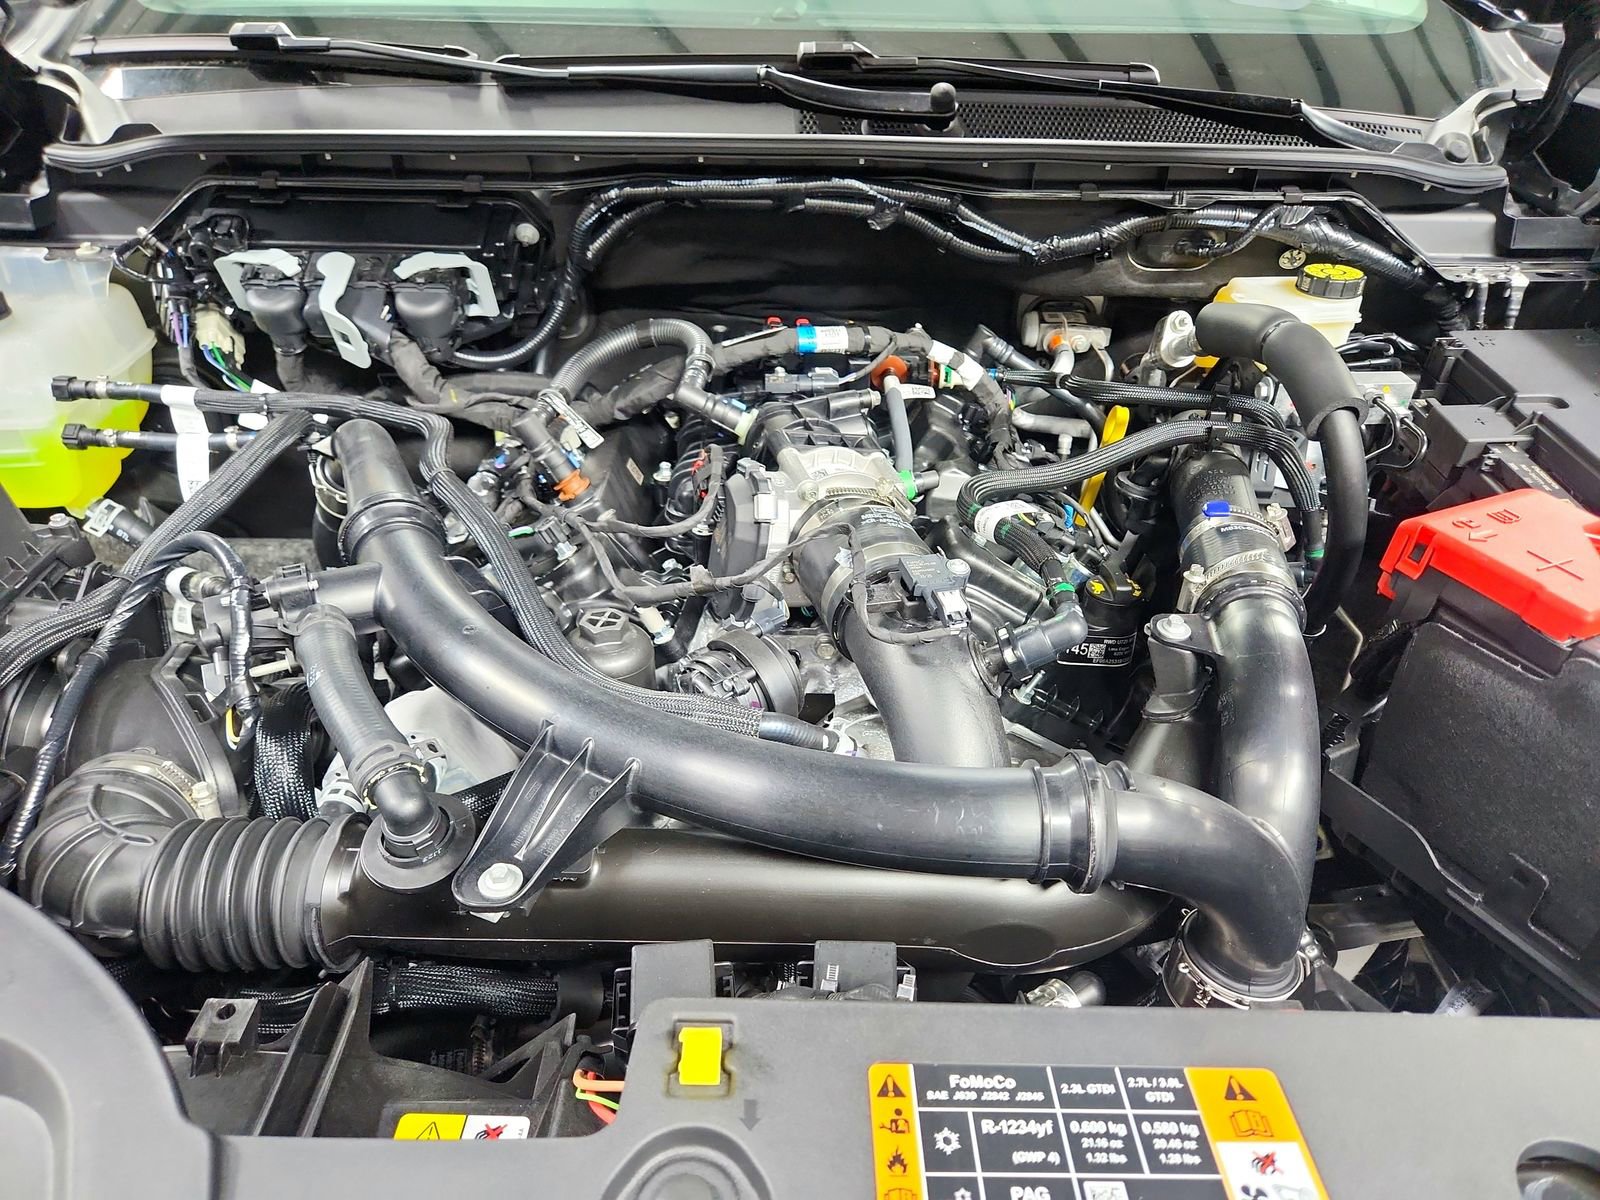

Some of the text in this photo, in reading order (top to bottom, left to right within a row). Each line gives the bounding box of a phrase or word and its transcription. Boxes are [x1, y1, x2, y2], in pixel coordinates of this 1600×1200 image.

[949, 1074, 1017, 1090] FoMoCo
[926, 1090, 950, 1101] SAE
[981, 1119, 1054, 1139] R-1234yf
[1107, 1120, 1128, 1138] kg
[1180, 1121, 1200, 1138] kg
[1012, 1151, 1046, 1166] (GWP
[1010, 1185, 1051, 1200] PAG
